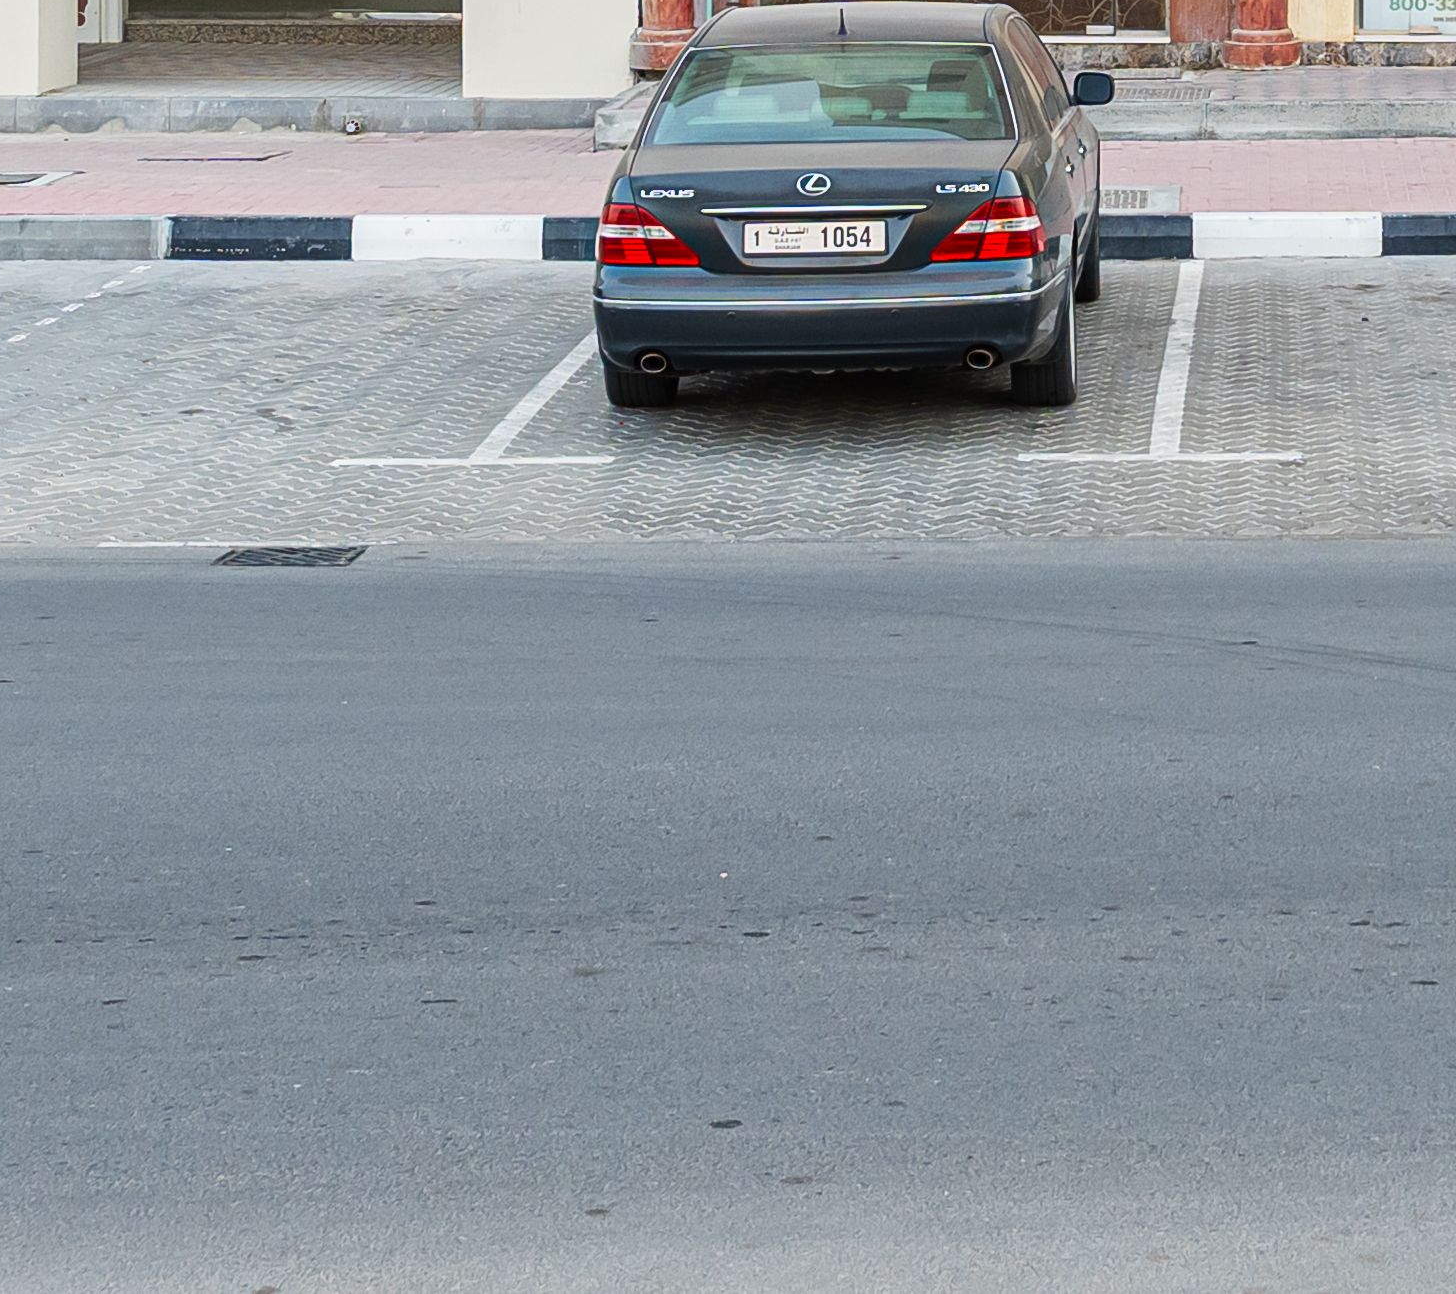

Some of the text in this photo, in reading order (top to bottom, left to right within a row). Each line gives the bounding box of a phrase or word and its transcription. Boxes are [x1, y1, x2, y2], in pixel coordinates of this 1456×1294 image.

[640, 189, 695, 198] LEXUS
[935, 183, 990, 194] LS 430
[754, 230, 760, 247] 1
[820, 226, 872, 248] 1054
